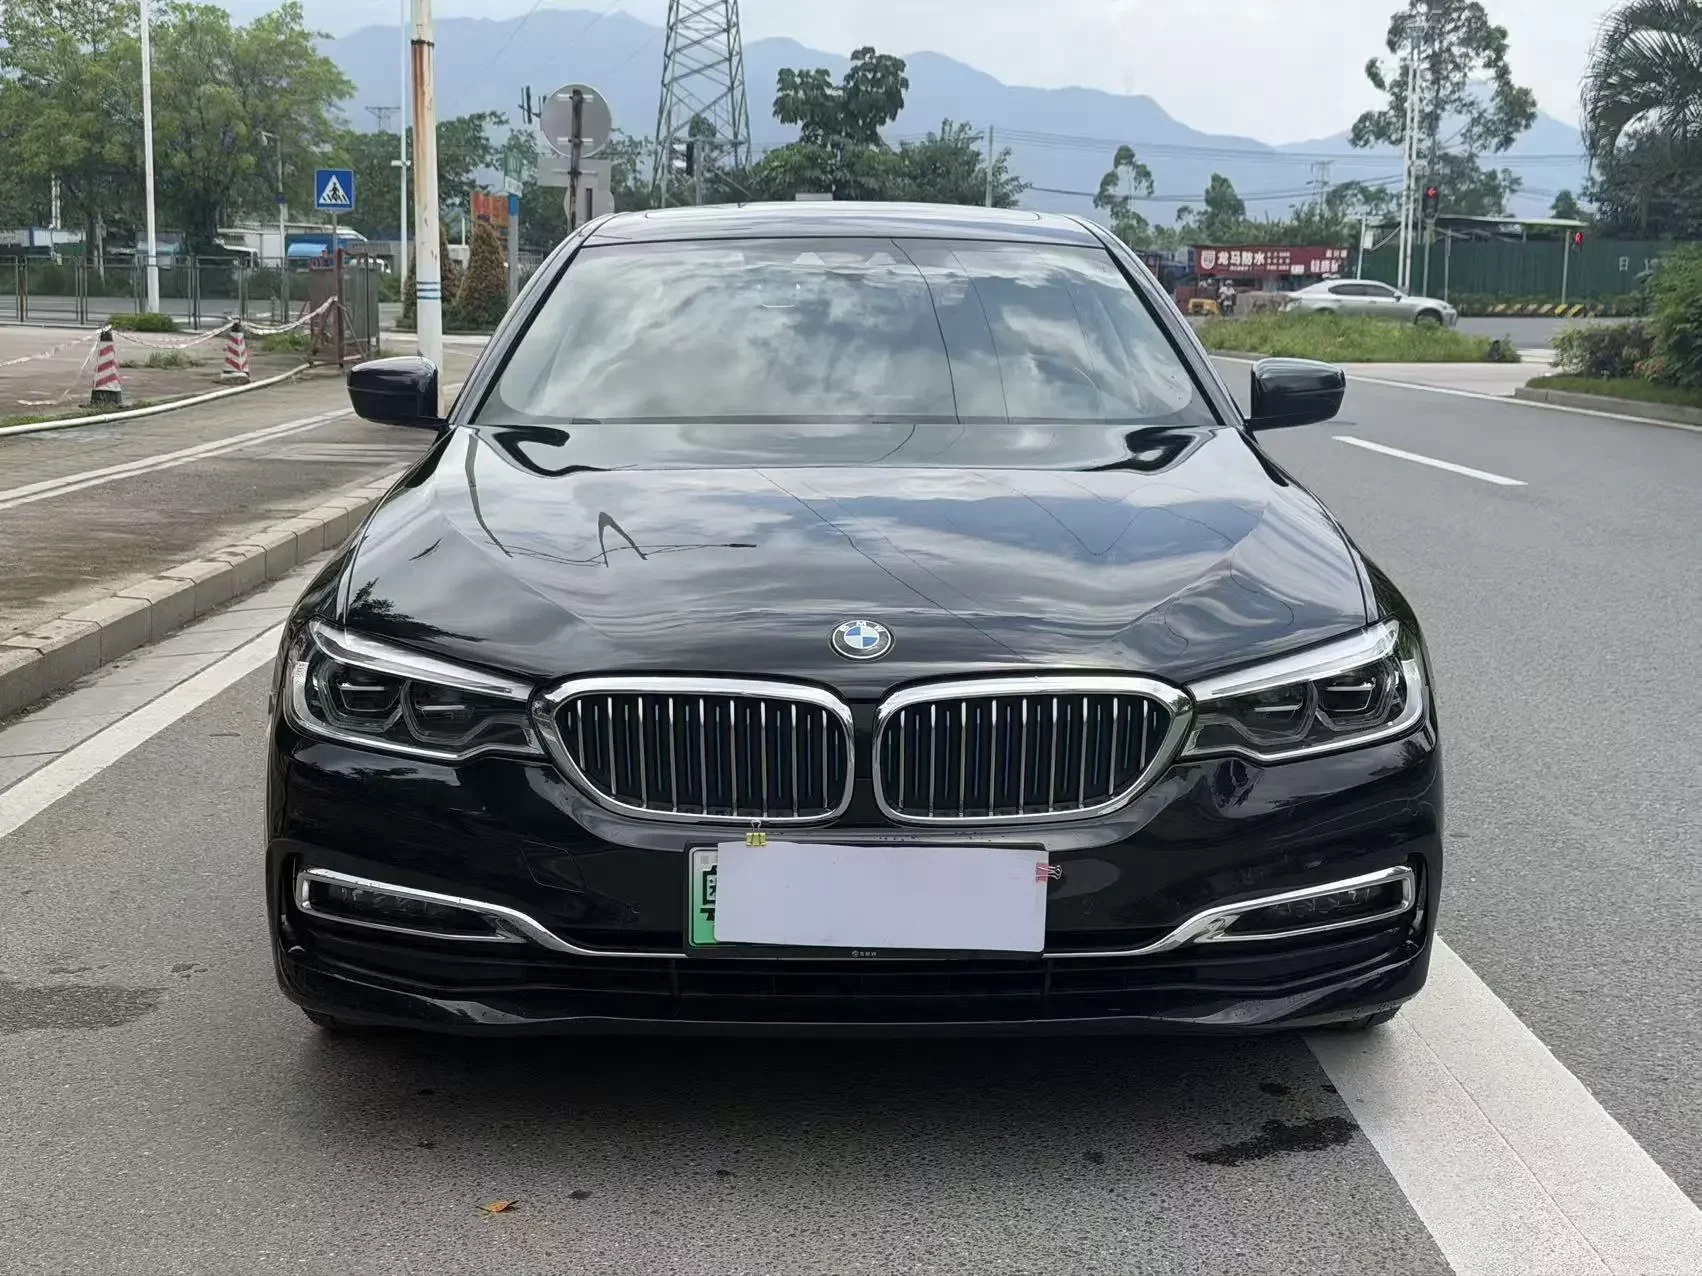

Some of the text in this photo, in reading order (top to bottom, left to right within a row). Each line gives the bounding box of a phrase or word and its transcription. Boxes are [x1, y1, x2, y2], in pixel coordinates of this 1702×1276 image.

[1217, 251, 1265, 265] 龙马防水
[838, 620, 885, 632] BMW
